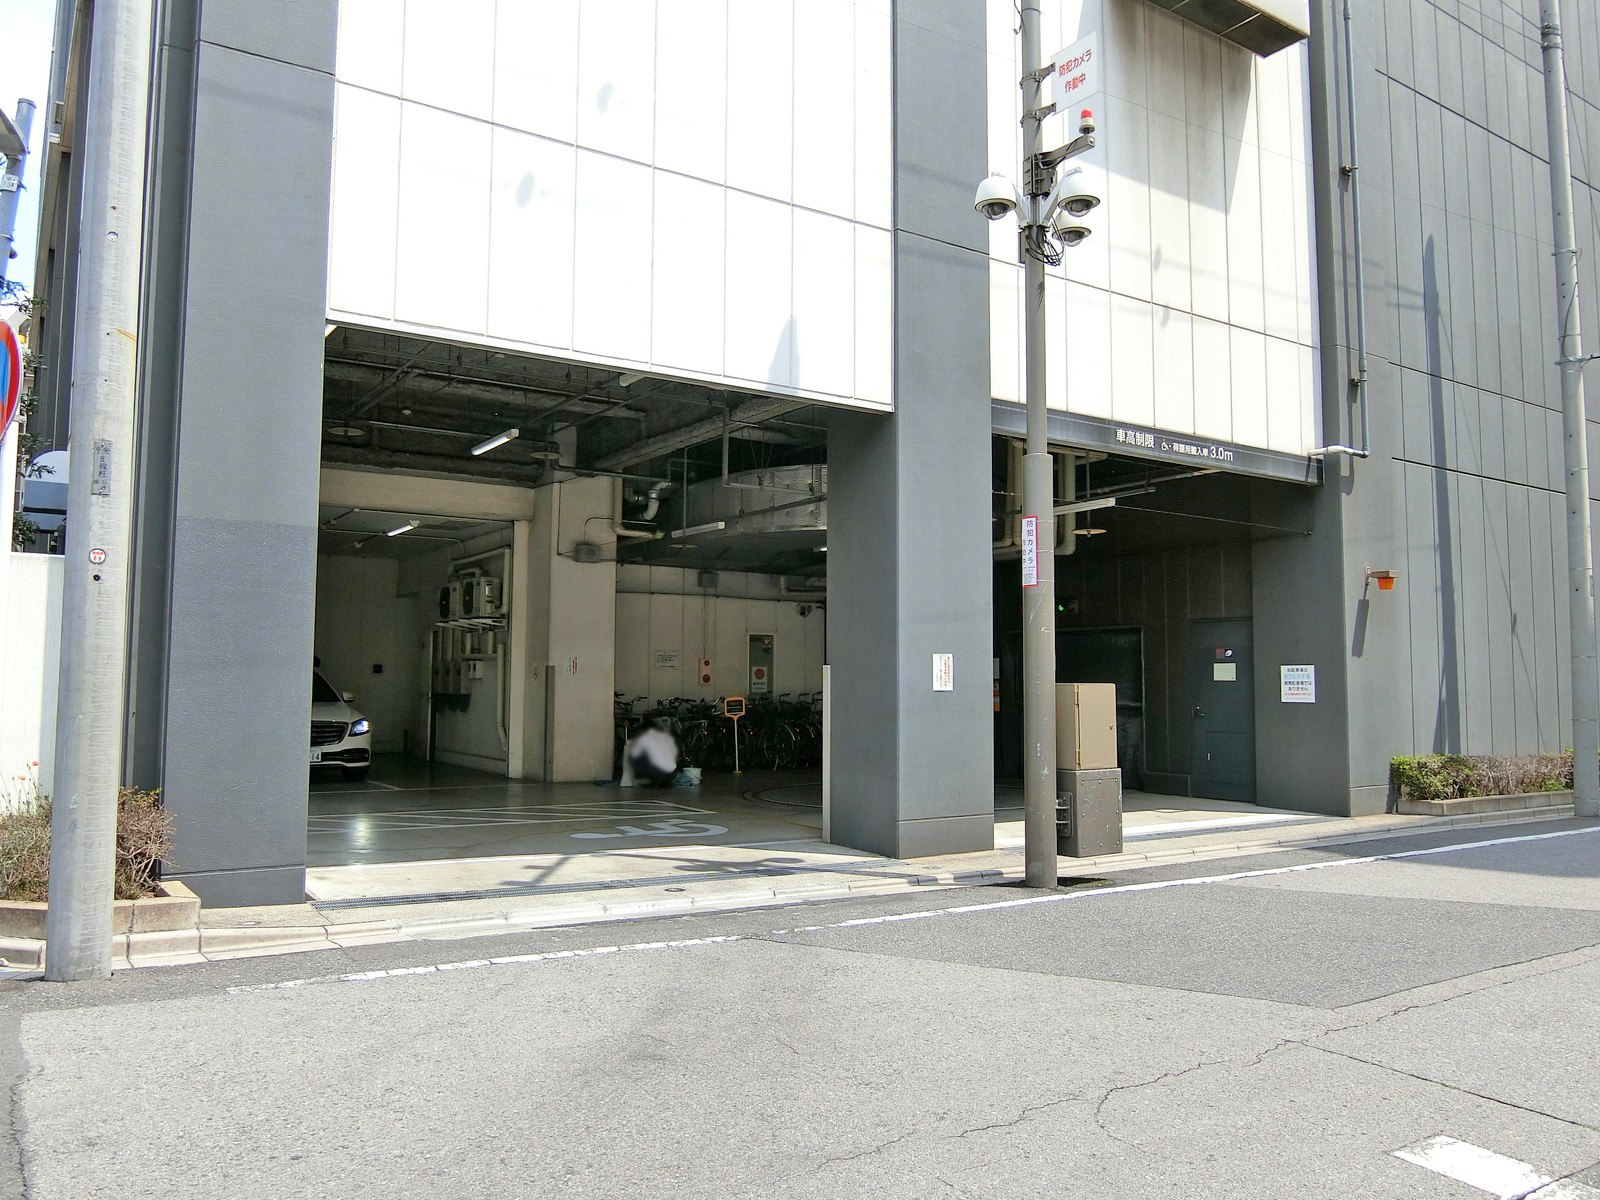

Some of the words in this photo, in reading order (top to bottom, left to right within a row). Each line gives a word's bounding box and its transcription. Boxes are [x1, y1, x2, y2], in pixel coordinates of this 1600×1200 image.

[1058, 49, 1092, 77] 防犯カメラ
[1064, 73, 1086, 94] 作動中
[1115, 428, 1155, 448] 車高制限
[1210, 445, 1234, 462] 3.0m
[1026, 519, 1034, 565] 防犯カメラ
